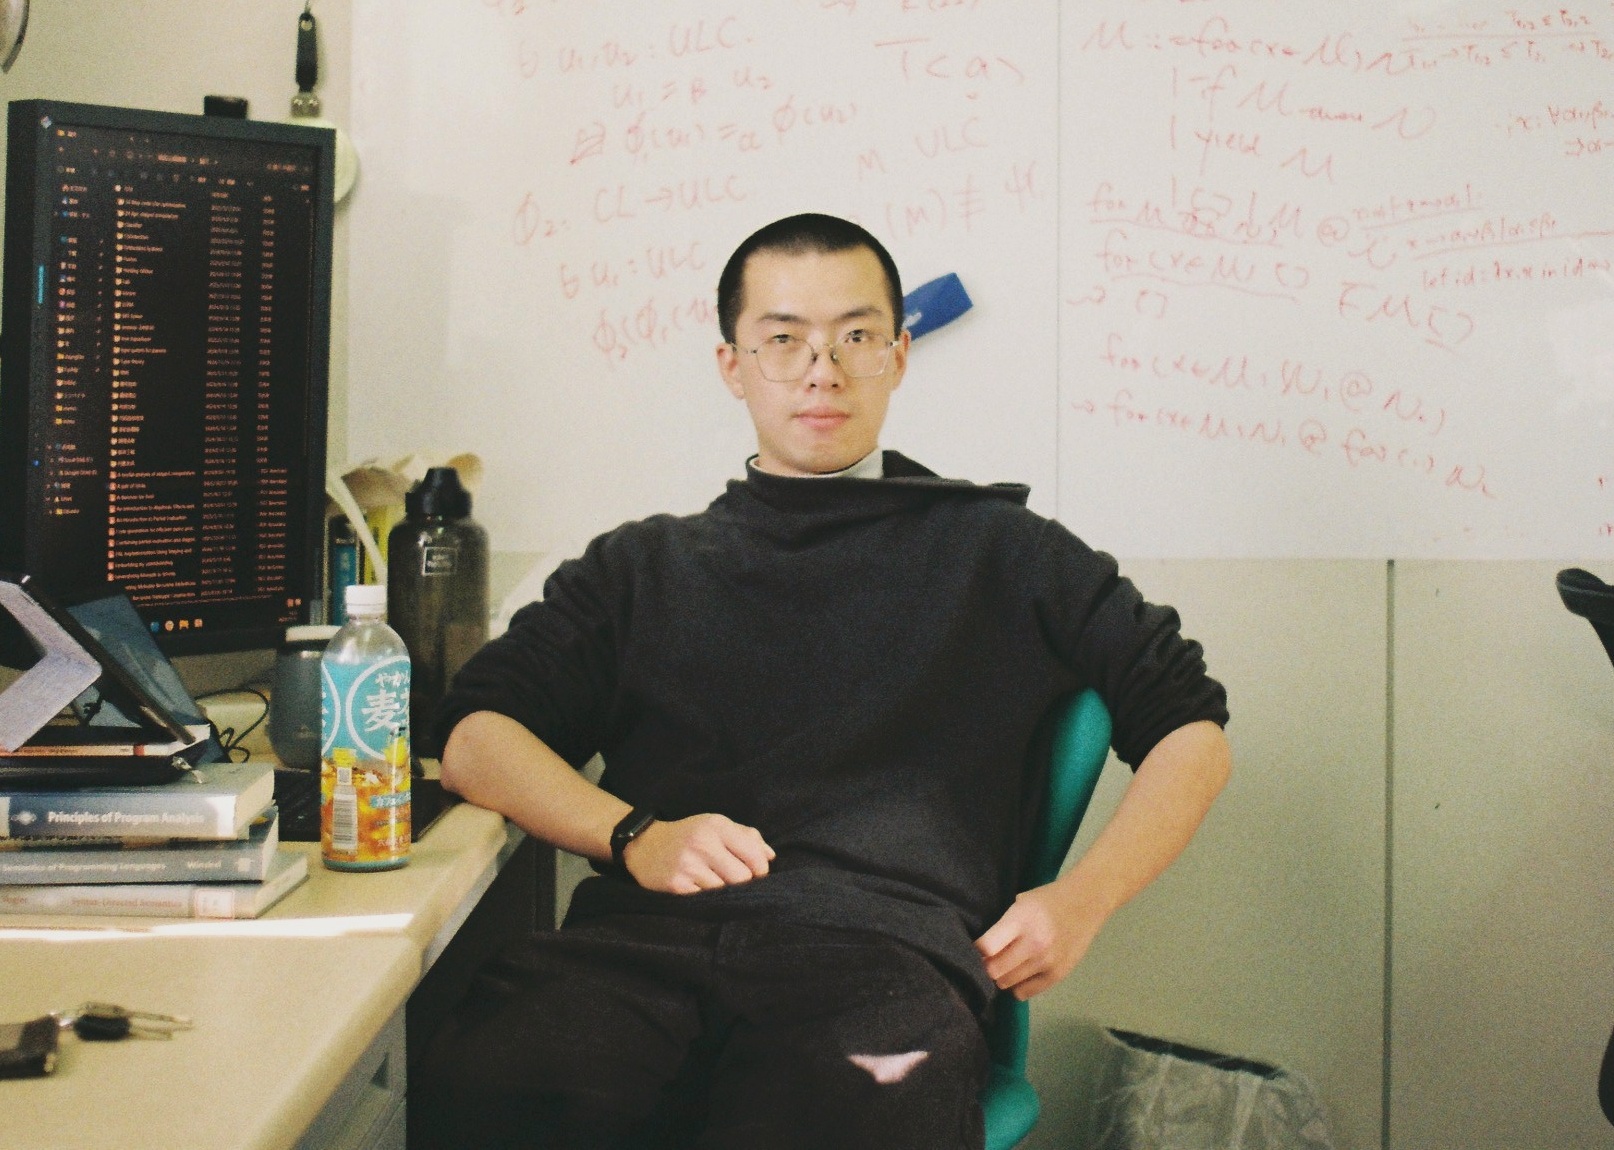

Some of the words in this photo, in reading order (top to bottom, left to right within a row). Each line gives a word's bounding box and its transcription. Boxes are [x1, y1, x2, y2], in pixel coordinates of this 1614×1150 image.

[48, 811, 100, 825] Principles
[101, 811, 113, 823] of
[114, 811, 160, 826] Program
[161, 812, 205, 825] Analysis
